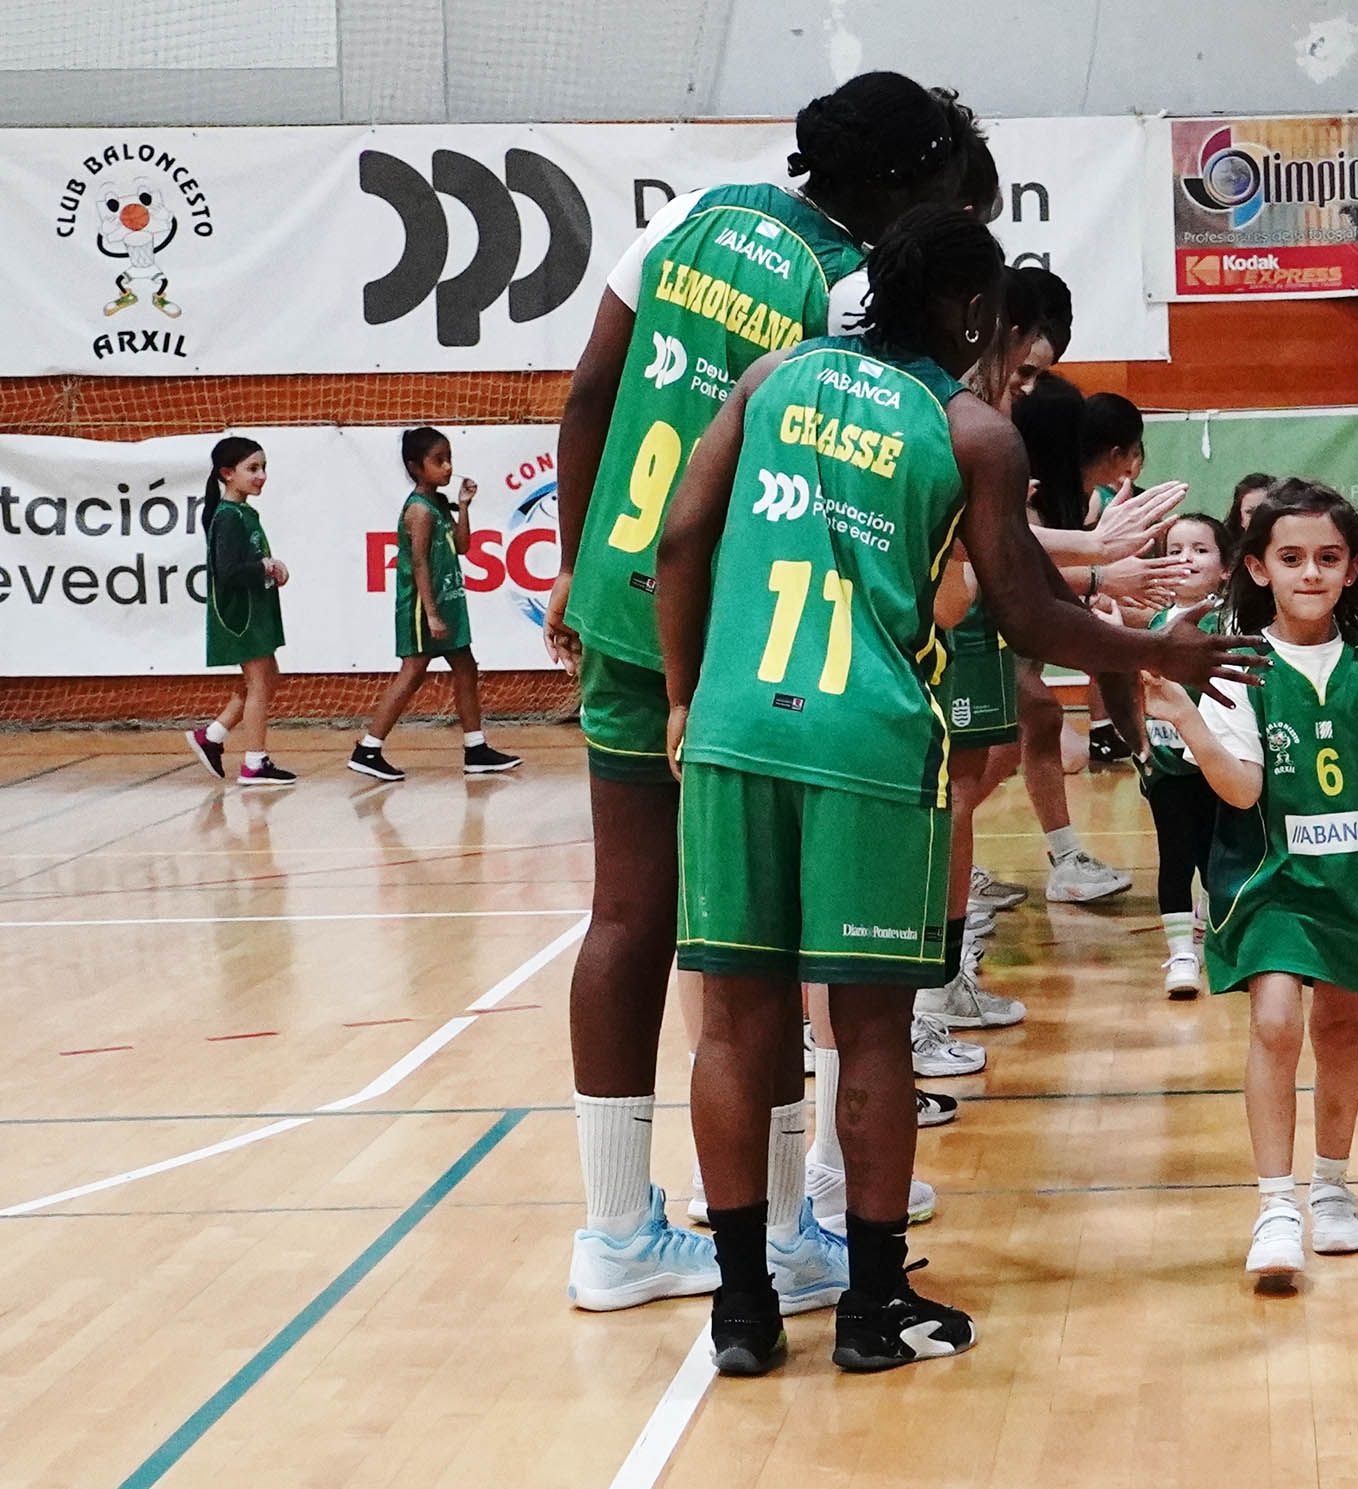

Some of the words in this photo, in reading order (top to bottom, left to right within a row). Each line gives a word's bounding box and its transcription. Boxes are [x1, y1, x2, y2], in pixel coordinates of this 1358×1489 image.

[56, 181, 87, 237] CLUB
[83, 143, 214, 237] BALONCESTO
[1222, 254, 1280, 271] Kodak
[1244, 266, 1343, 284] EXPRESS
[93, 330, 189, 359] ARXIL
[779, 404, 905, 479] CHASSÉ
[608, 420, 701, 553] 9
[366, 528, 558, 592] PSC
[757, 560, 853, 695] 11
[1316, 747, 1344, 797] 6
